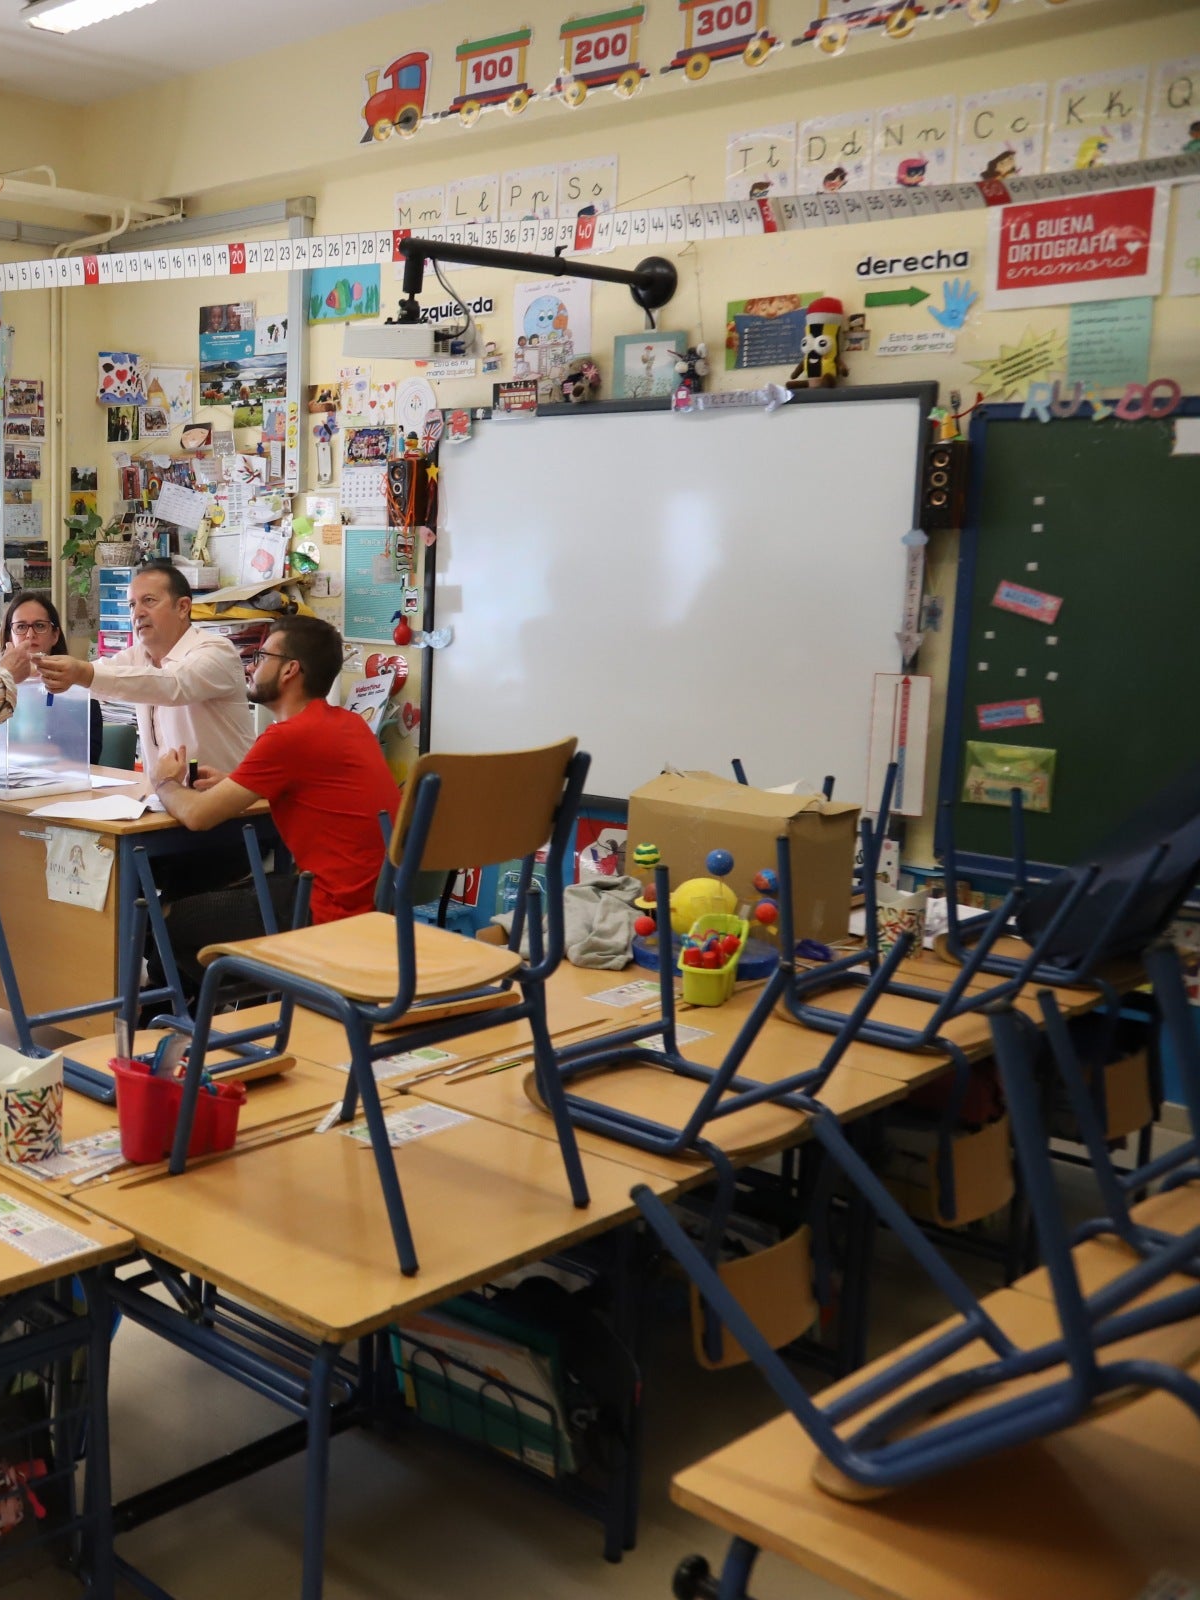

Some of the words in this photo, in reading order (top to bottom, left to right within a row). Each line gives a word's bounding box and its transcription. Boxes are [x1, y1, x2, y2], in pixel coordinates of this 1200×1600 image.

[697, 1, 752, 36] 300
[574, 33, 627, 65] 200
[472, 55, 513, 84] 100
[1167, 77, 1193, 109] Q
[1066, 96, 1086, 124] K
[884, 125, 903, 147] N
[917, 127, 945, 141] n
[974, 111, 994, 138] C
[1010, 117, 1029, 133] c
[739, 148, 753, 171] T
[766, 146, 780, 167] t
[808, 136, 827, 162] D
[840, 131, 862, 156] d
[510, 185, 521, 206] P
[532, 190, 549, 213] p
[568, 177, 581, 199] S
[592, 183, 603, 195] s
[399, 208, 412, 226] M
[418, 210, 441, 221] m
[455, 196, 467, 216] L
[479, 191, 488, 212] l
[9, 270, 14, 281] 4
[22, 268, 27, 280] 5
[35, 267, 40, 279] 6
[48, 267, 53, 278] 7
[61, 266, 67, 277] 8
[75, 264, 80, 276] 9
[87, 263, 96, 275] 10
[102, 263, 109, 274] 11
[114, 261, 123, 273] 12
[129, 260, 138, 272] 13
[143, 258, 152, 271] 14
[158, 257, 167, 269] 15
[173, 256, 181, 269] 16
[188, 254, 196, 267] 17
[203, 253, 212, 266] 18
[218, 252, 227, 265] 19
[232, 251, 243, 264] 20
[249, 250, 258, 262] 21
[264, 249, 274, 261] 22
[280, 248, 290, 260] 23
[296, 246, 306, 259] 24
[312, 244, 323, 257] 25
[329, 243, 339, 256] 26
[345, 242, 356, 255] 27
[362, 241, 373, 254] 28
[380, 239, 390, 253] 29
[467, 232, 478, 245] 34
[486, 230, 497, 245] 35
[504, 229, 516, 243] 36
[522, 228, 535, 242] 37
[540, 227, 554, 240] 38
[560, 226, 573, 240] 39
[578, 224, 592, 239] 40
[598, 222, 609, 236] 41
[616, 220, 628, 235] 42
[634, 218, 646, 233] 43
[652, 216, 664, 231] 44
[670, 214, 682, 229] 45
[689, 212, 701, 228] 46
[707, 211, 719, 226] 47
[725, 209, 740, 224] 48
[747, 207, 758, 222] 49
[784, 204, 797, 219] 51
[804, 202, 818, 217] 52
[825, 201, 840, 214] 53
[845, 199, 861, 213] 54
[867, 196, 884, 210] 55
[888, 194, 907, 208] 56
[912, 192, 928, 205] 57
[934, 190, 953, 202] 58
[959, 187, 976, 199] 59
[1011, 182, 1028, 192] 61
[1009, 223, 1030, 242] LA
[1036, 214, 1094, 239] BUENA
[1008, 233, 1117, 263] ORTOGRAFÍA
[857, 250, 969, 276] derecha
[1007, 256, 1132, 279] enamora
